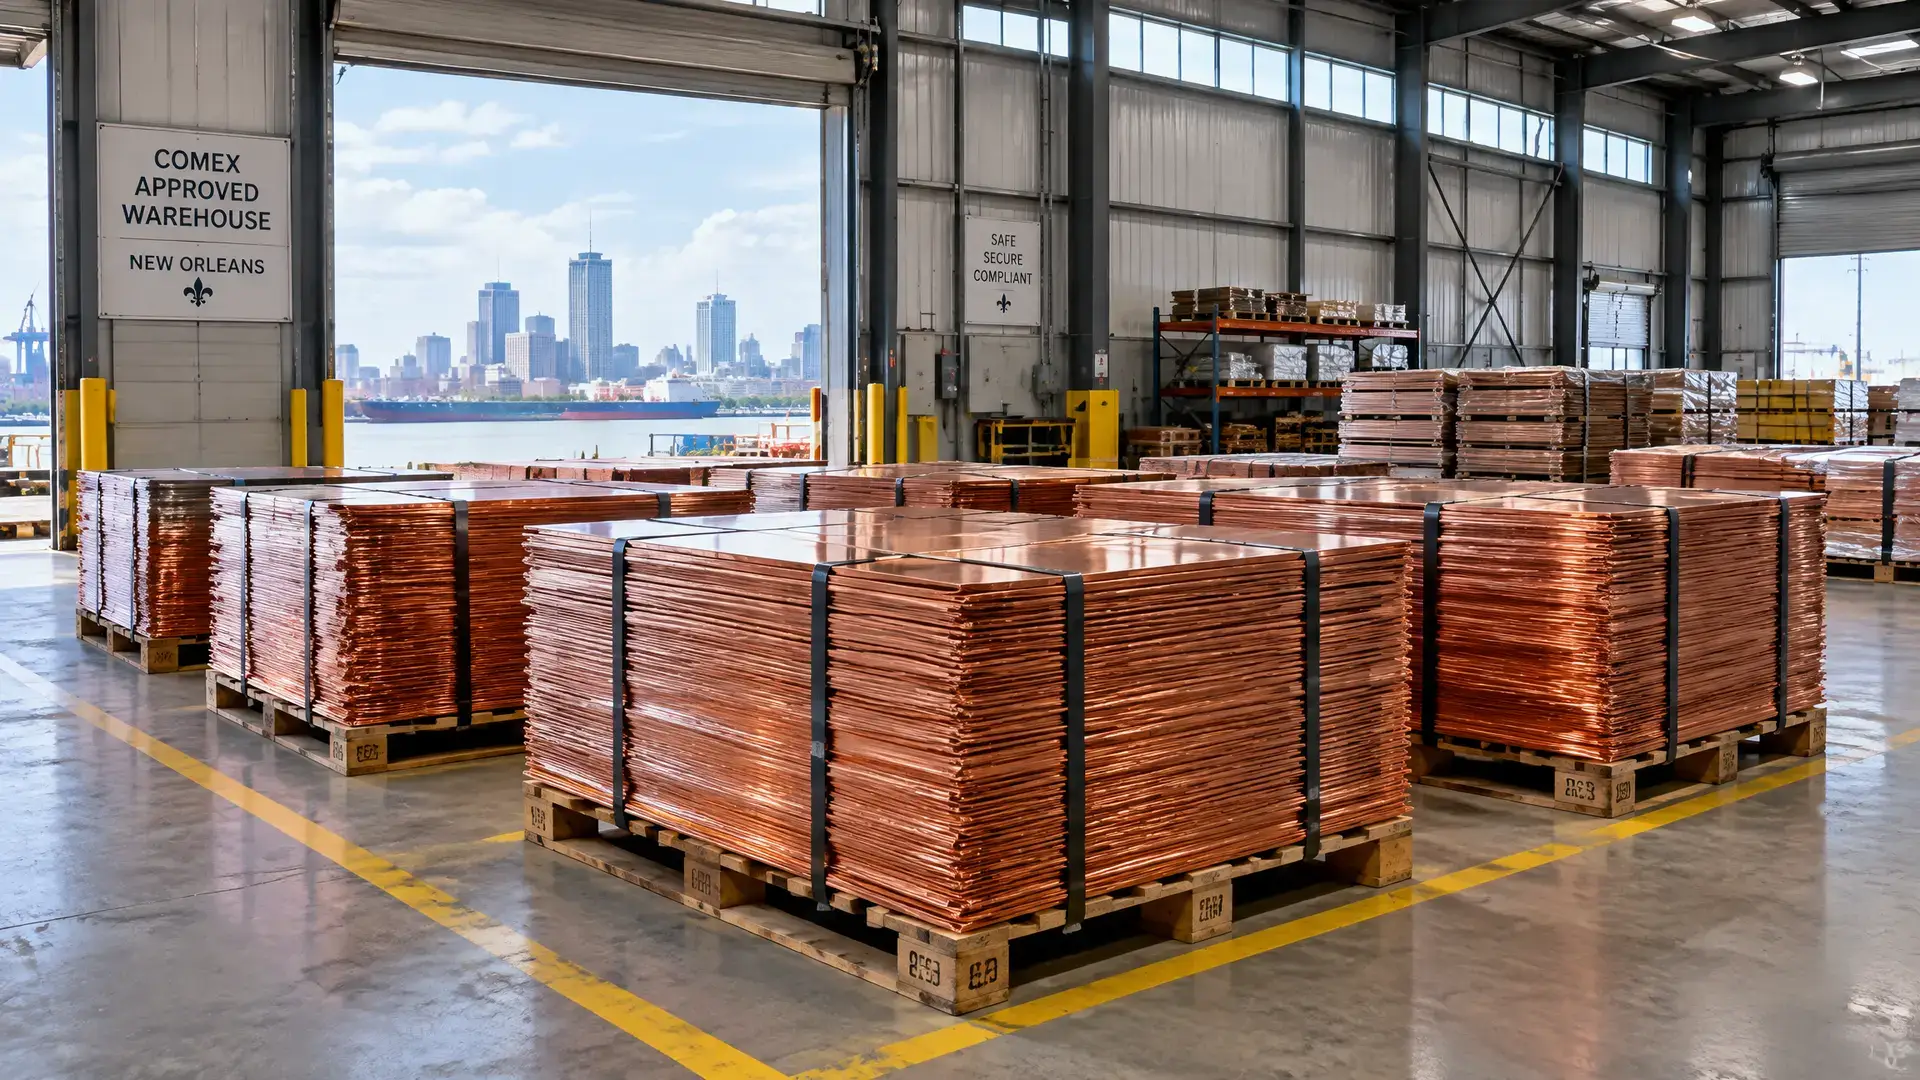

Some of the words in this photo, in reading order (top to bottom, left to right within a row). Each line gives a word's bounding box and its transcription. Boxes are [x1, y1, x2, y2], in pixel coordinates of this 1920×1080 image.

[154, 148, 241, 174] COMEX
[134, 176, 259, 202] APPROVED
[121, 204, 272, 231] WAREHOUSE
[991, 233, 1016, 247] SAFE
[129, 254, 174, 271] NEW
[179, 256, 265, 275] ORLEANS
[983, 251, 1023, 266] SECURE
[973, 269, 1033, 285] COMPLIANT
